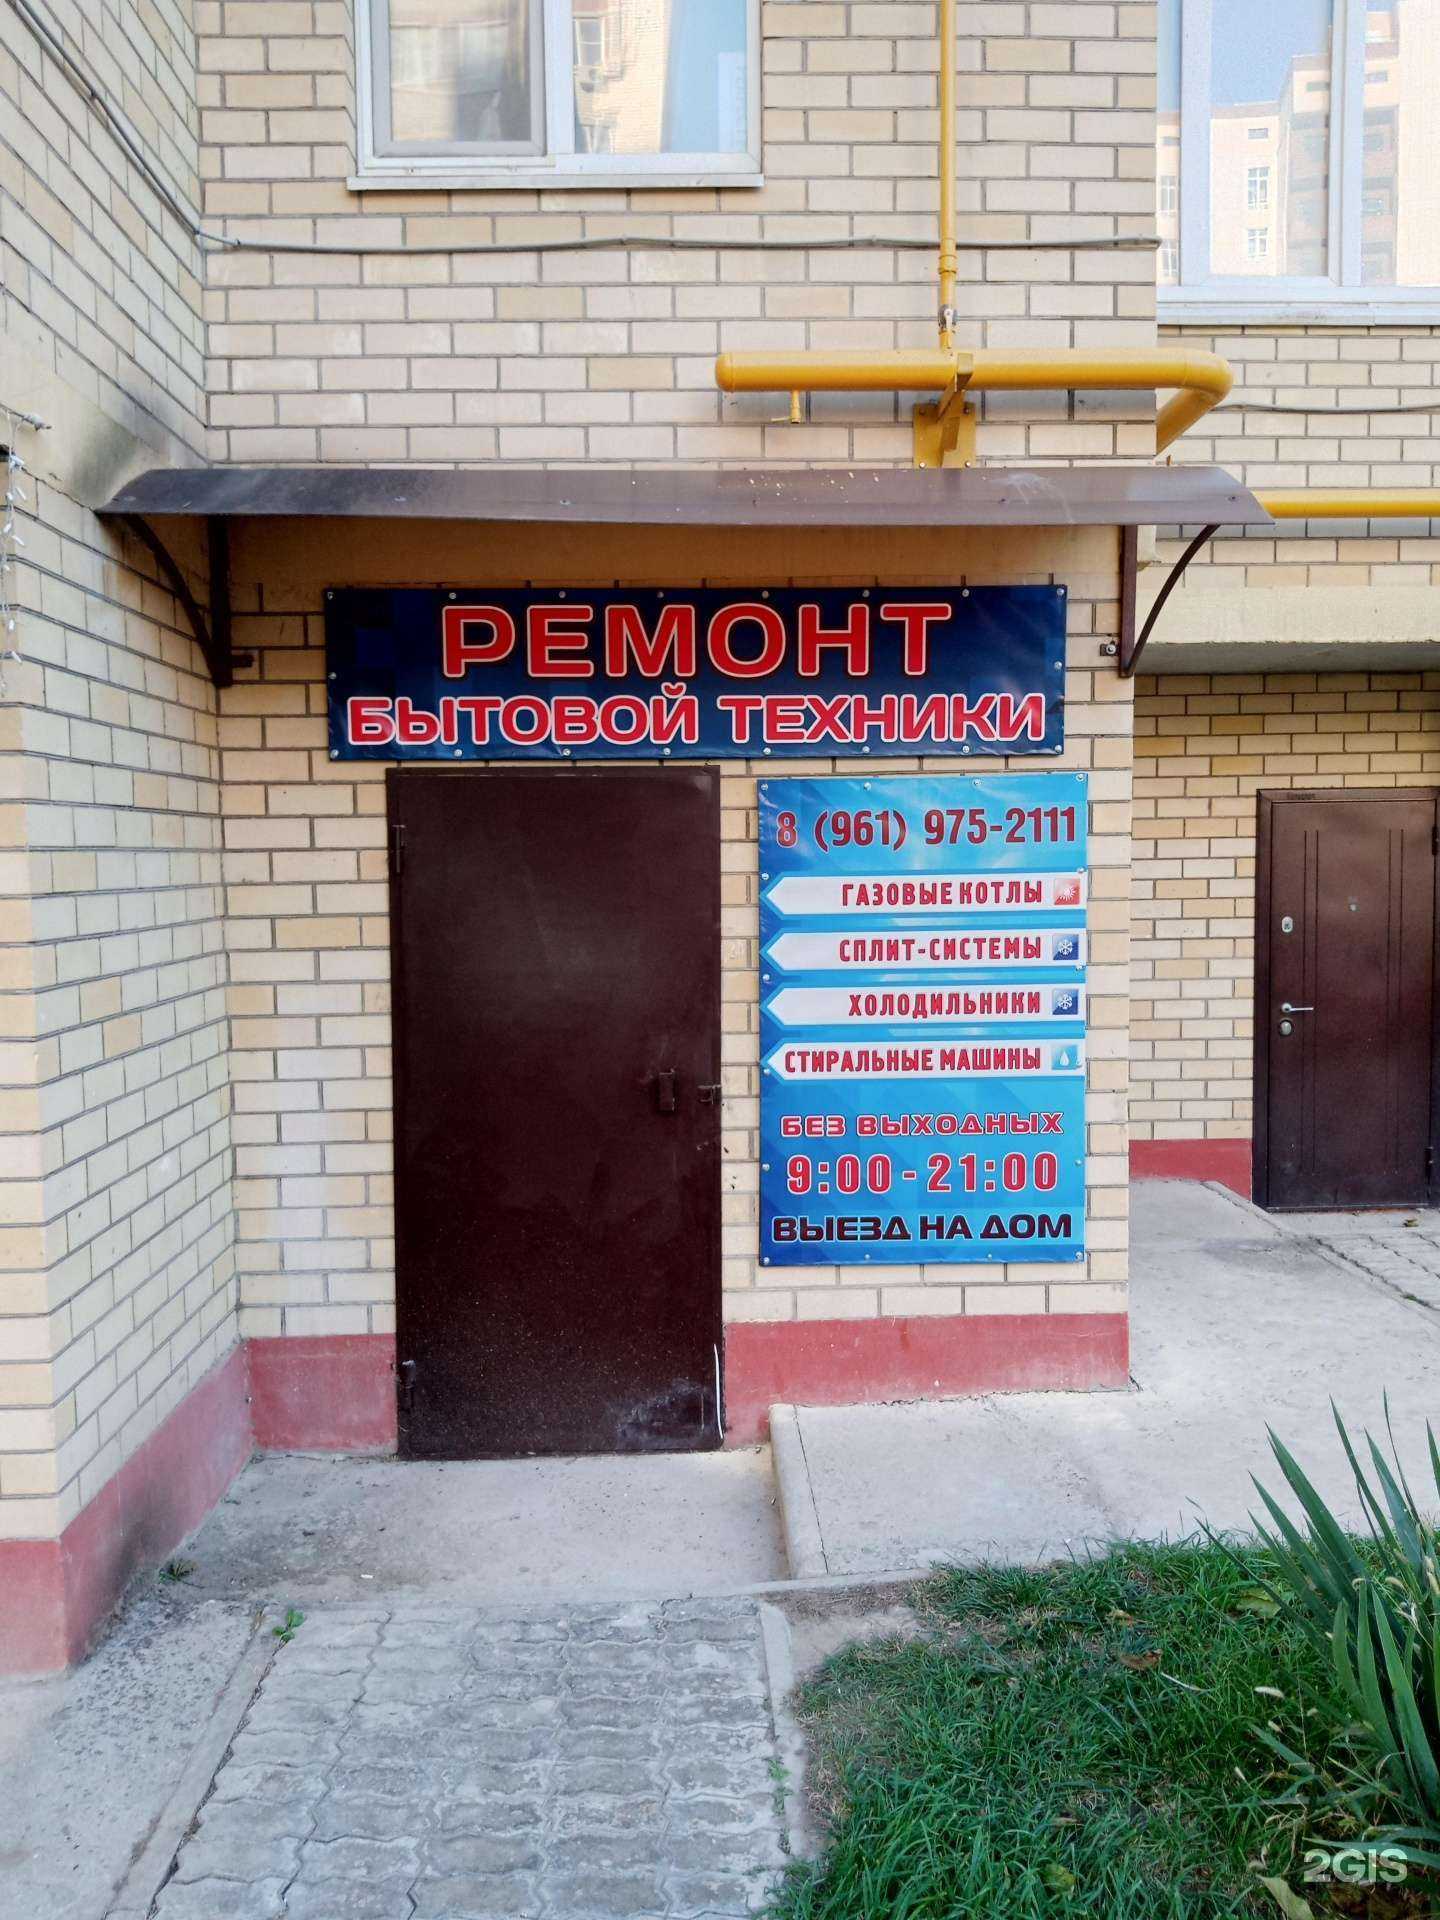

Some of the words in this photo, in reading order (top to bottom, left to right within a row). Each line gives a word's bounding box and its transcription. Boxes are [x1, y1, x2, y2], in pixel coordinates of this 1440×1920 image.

[441, 604, 952, 679] РЕМОНТ
[346, 682, 699, 746] БЫТОВОЙ
[716, 692, 1046, 743] ТЕХНИКИ
[777, 811, 798, 848] 8
[814, 809, 907, 852] (961)
[924, 806, 1077, 846] 975-2111
[842, 883, 952, 906] ГАЗОВЫЕ
[959, 880, 1042, 904] КОТЛЫ
[839, 936, 1042, 962] СПЛИТ-СИСТЕМЫ
[848, 991, 1041, 1019] ХОЛОДИЛЬНИКИ
[784, 1050, 933, 1073] СТИРАЛЬНЫЕ
[939, 1047, 1041, 1070] МАШИНЫ
[780, 1114, 846, 1138] БЕЗ
[856, 1112, 1064, 1137] ВЫХОДНЫХ
[786, 1152, 1058, 1195] 9:00-21:00
[772, 1215, 911, 1243] ВЫЕЗД
[919, 1215, 973, 1240] НА
[979, 1213, 1072, 1239] ДОМ
